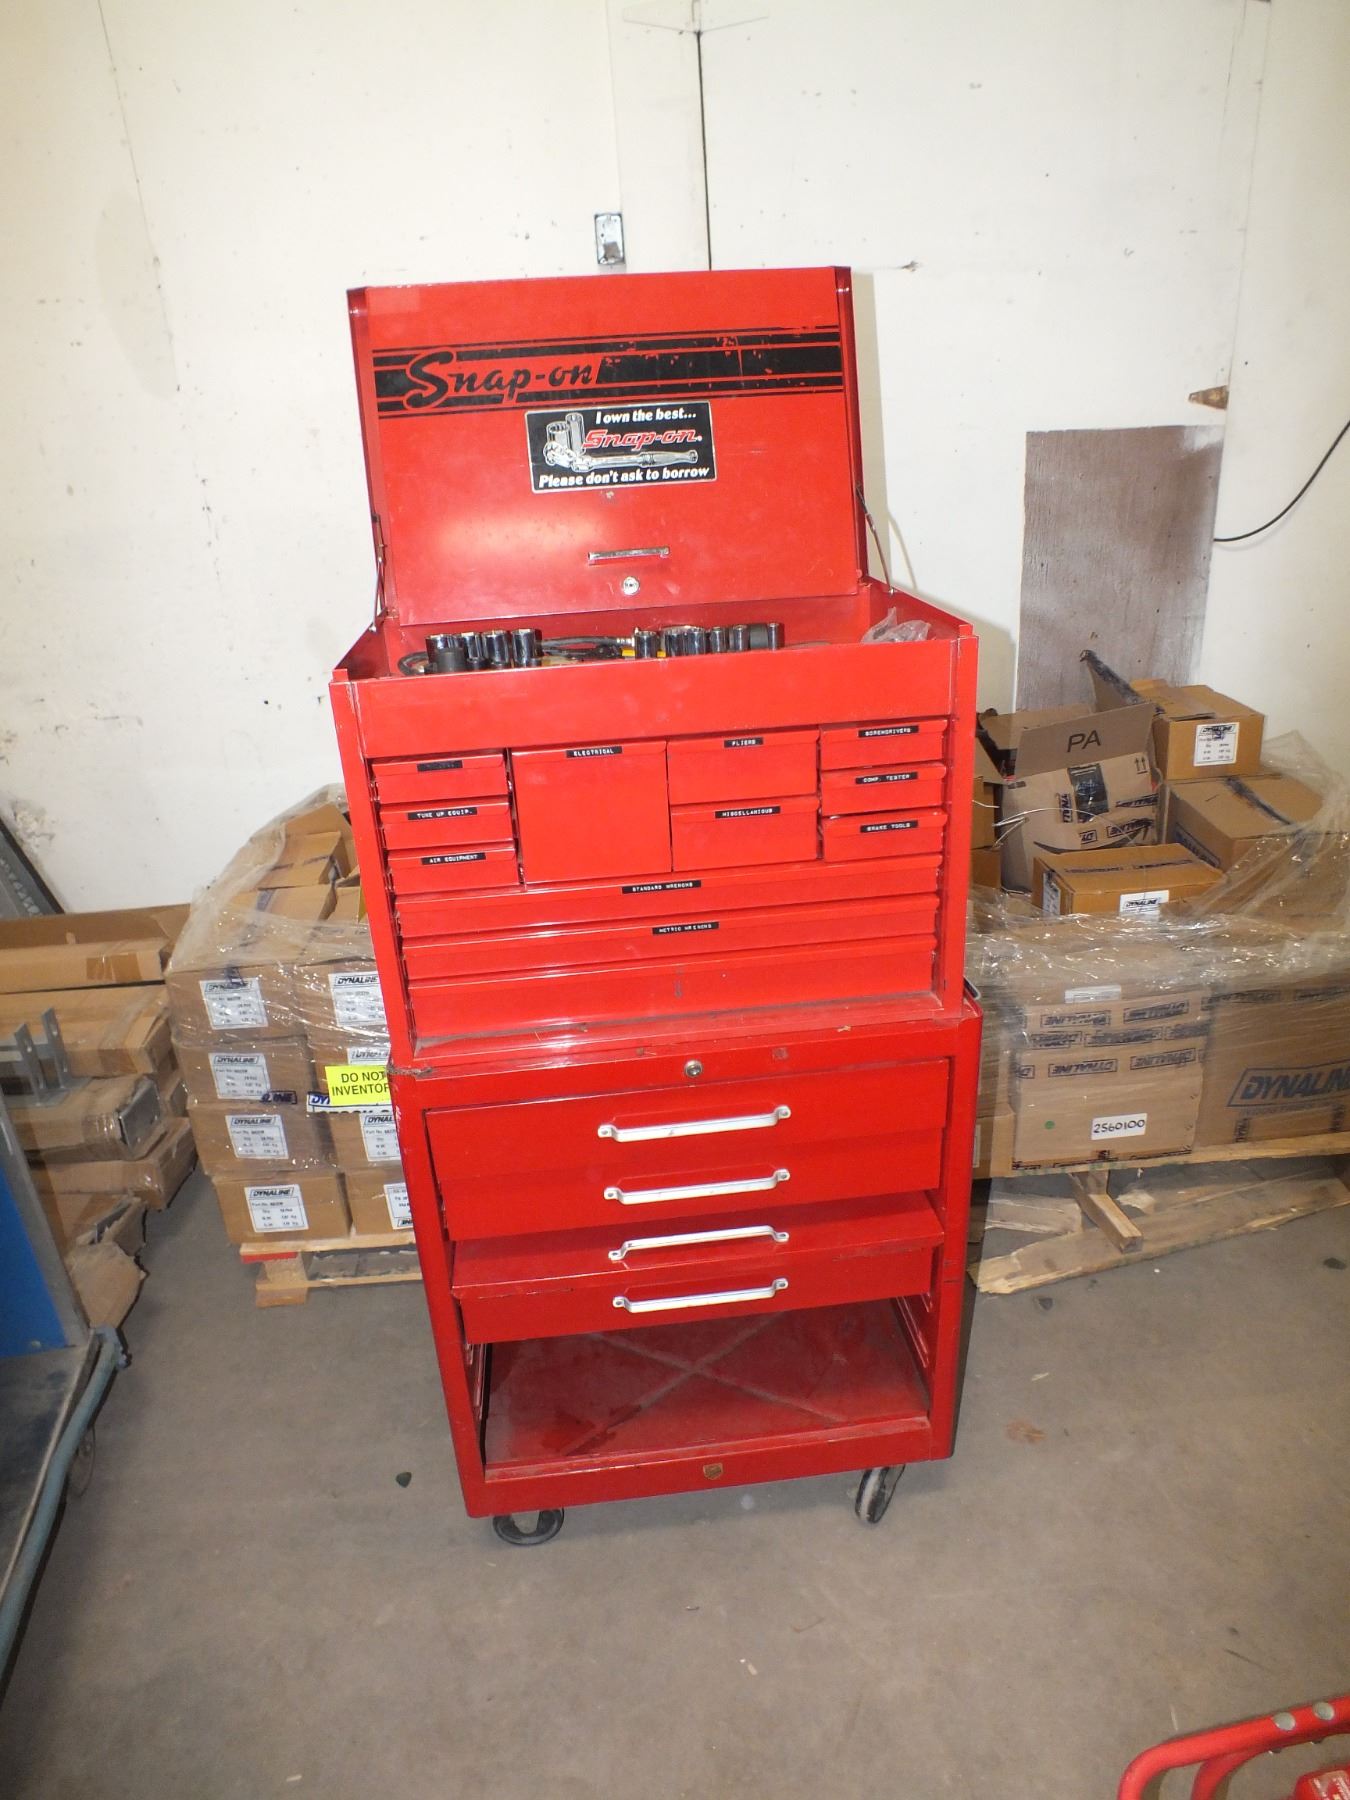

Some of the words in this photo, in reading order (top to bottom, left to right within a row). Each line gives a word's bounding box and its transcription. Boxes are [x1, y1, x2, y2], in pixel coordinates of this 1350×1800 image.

[406, 351, 593, 408] Snap-on
[603, 411, 630, 424] own
[632, 409, 653, 422] the
[656, 407, 697, 421] best...
[538, 474, 583, 489] Please
[586, 470, 619, 485] don't
[621, 468, 644, 482] ask
[646, 467, 659, 480] to
[662, 466, 710, 479] borrow
[864, 726, 912, 737] SCREWDRIVERS
[731, 737, 757, 746] PLIERS
[1067, 730, 1102, 752] PA
[573, 748, 615, 757] ELECTRICAL
[885, 773, 910, 781] TESTER
[417, 811, 433, 819] TUNE
[436, 810, 445, 818] UP
[866, 824, 888, 832] BRAKE
[891, 822, 911, 830] TOOLS
[429, 856, 442, 864] AIR
[444, 853, 478, 863] EQUIPMENT
[632, 884, 662, 892] STANDARD
[341, 1072, 359, 1083] DO
[362, 1071, 386, 1081] NOT
[1093, 1119, 1145, 1133] 2560100
[253, 1188, 291, 1197] DYNALINE
